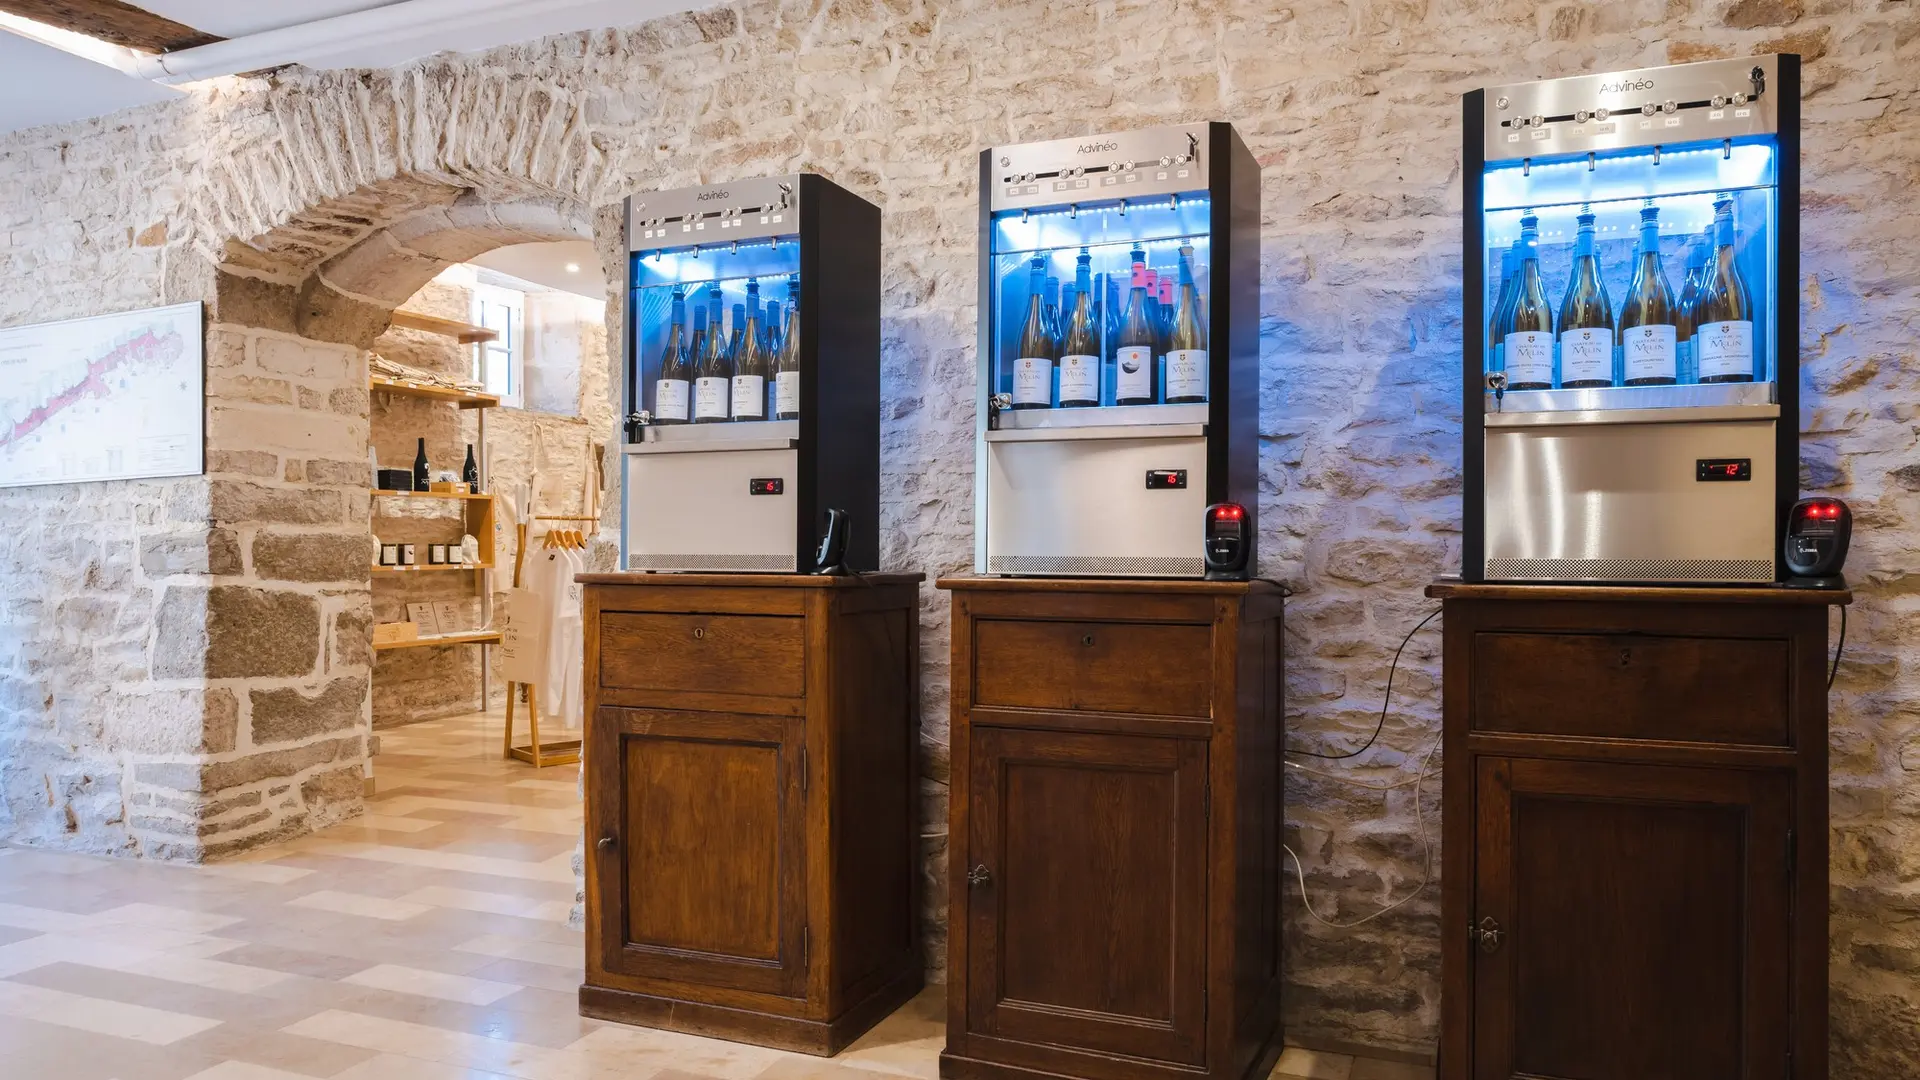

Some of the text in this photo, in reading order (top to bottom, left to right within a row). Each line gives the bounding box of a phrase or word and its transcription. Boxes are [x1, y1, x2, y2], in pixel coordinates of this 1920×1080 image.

[1599, 77, 1654, 95] Advinéo
[1076, 139, 1118, 154] Advinéo
[696, 189, 730, 202] Advinéo
[1634, 343, 1664, 354] MELIN
[1709, 339, 1742, 350] MELIN
[1517, 348, 1545, 359] MELIN
[1572, 346, 1602, 357] MELIN
[1726, 463, 1739, 475] 12
[1167, 474, 1177, 484] 16
